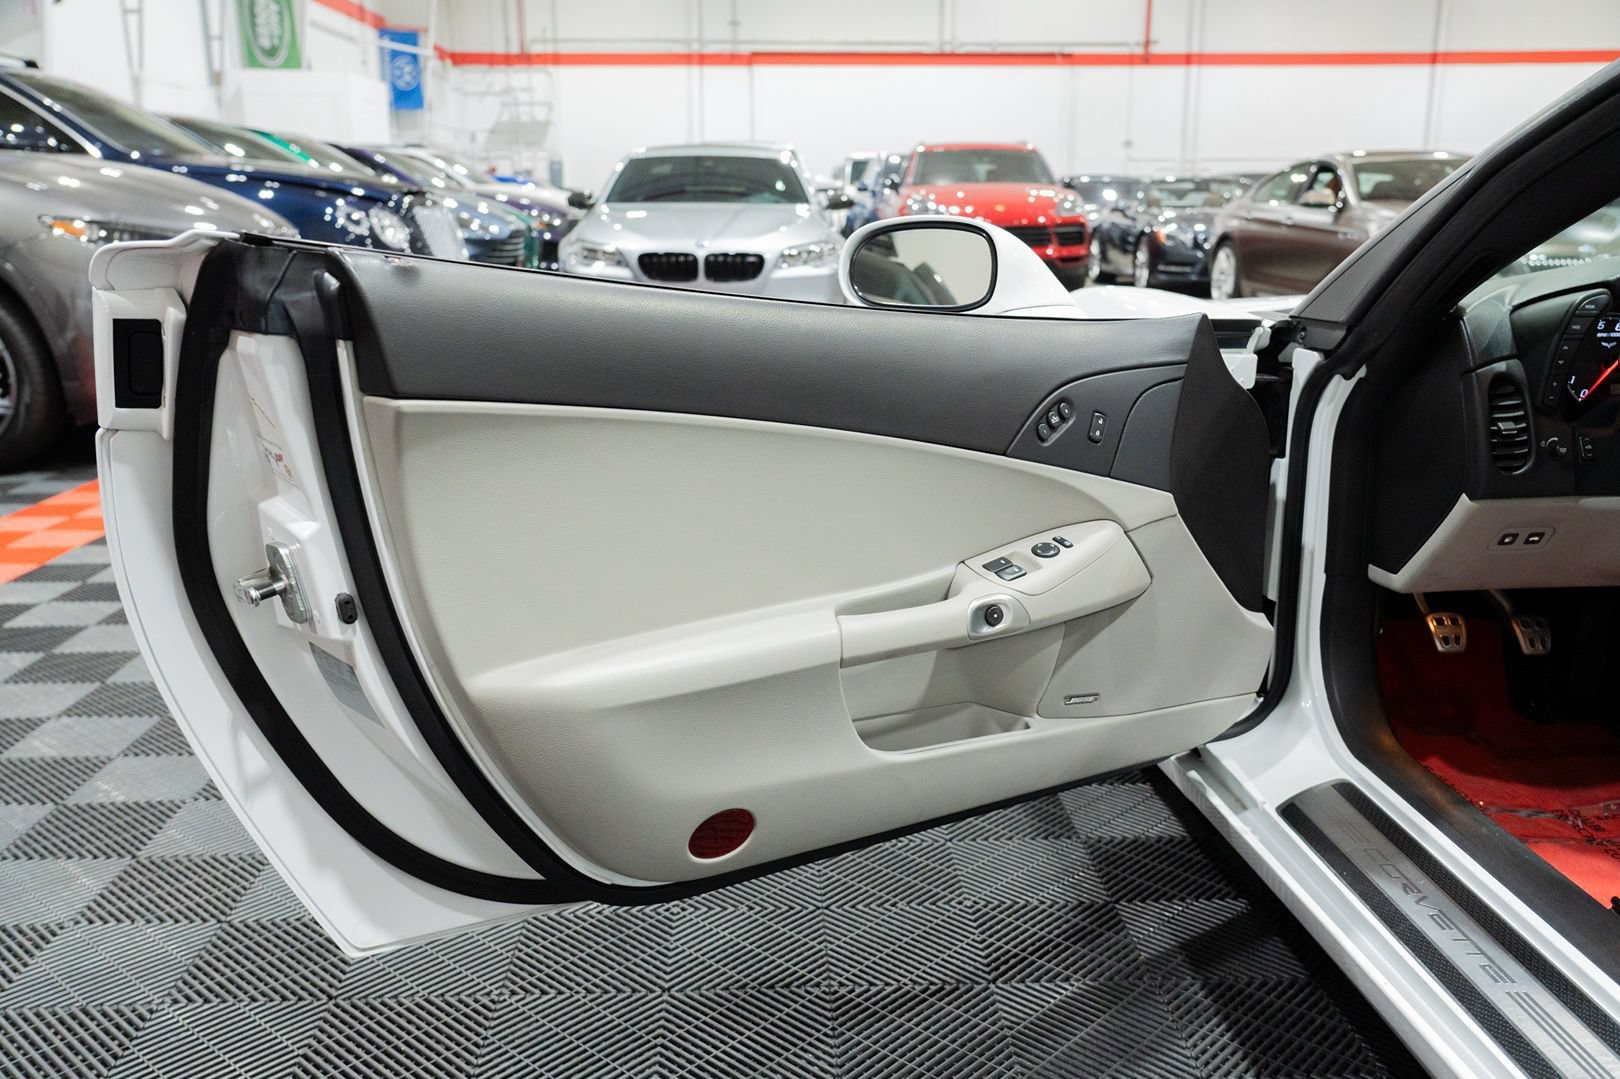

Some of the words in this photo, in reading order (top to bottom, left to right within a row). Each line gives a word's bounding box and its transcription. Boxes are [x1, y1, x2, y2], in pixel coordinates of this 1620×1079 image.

[1597, 321, 1606, 330] 5
[1579, 388, 1589, 398] 0
[1363, 847, 1518, 984] CORVETTE
